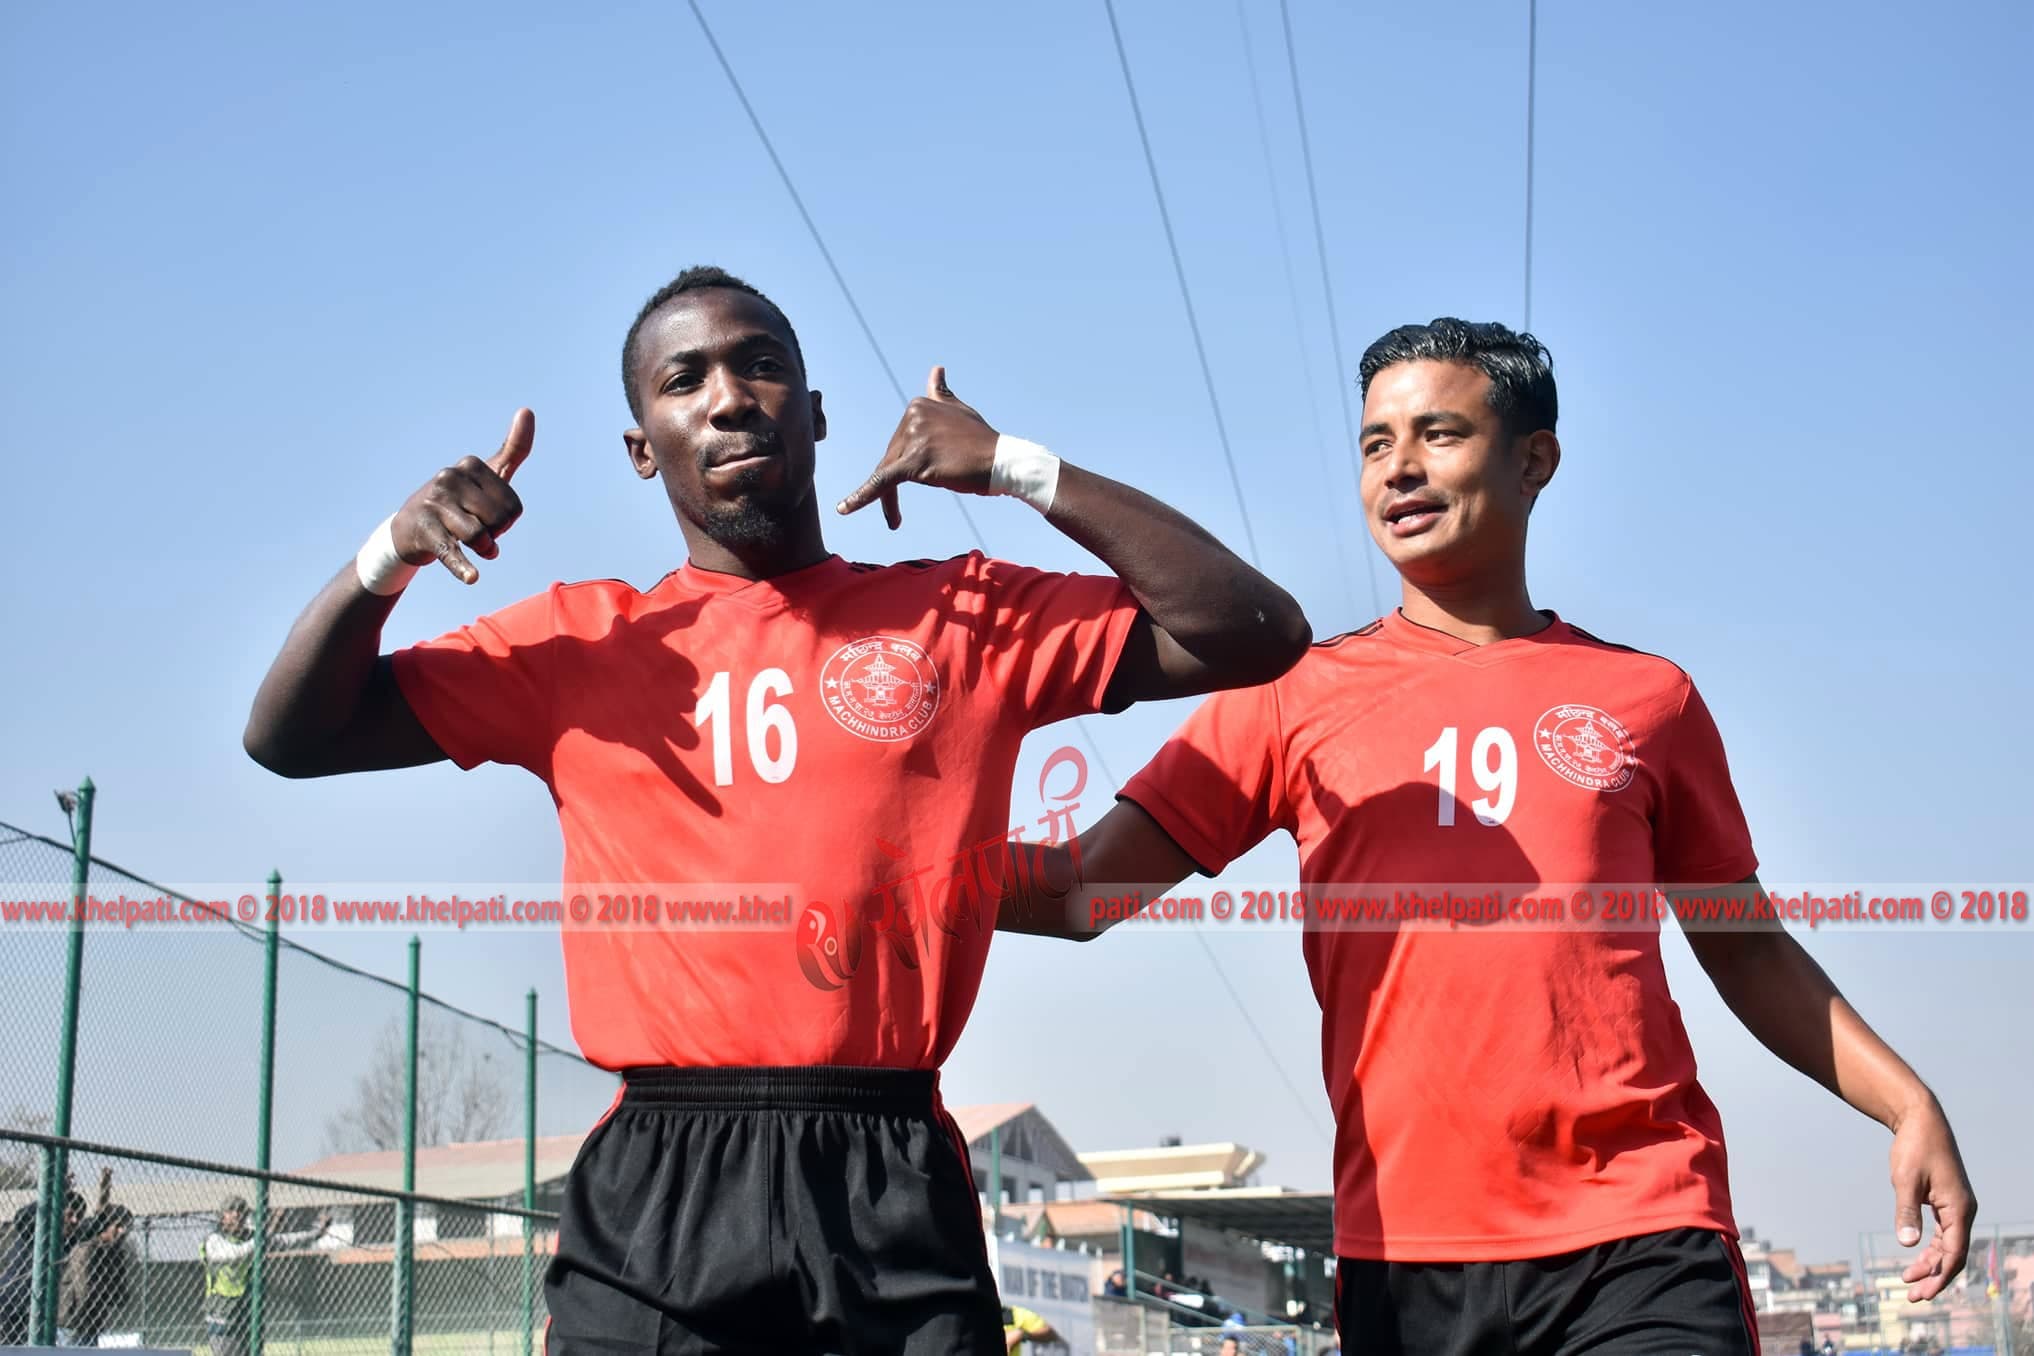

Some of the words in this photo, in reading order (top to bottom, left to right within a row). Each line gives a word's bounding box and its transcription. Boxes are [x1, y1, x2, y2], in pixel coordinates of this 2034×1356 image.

[695, 667, 798, 786] 16
[828, 696, 908, 737] MACHHINDRA
[908, 700, 933, 730] CLUB
[1424, 727, 1518, 826] 19
[1540, 744, 1610, 788] MACHHINDRA
